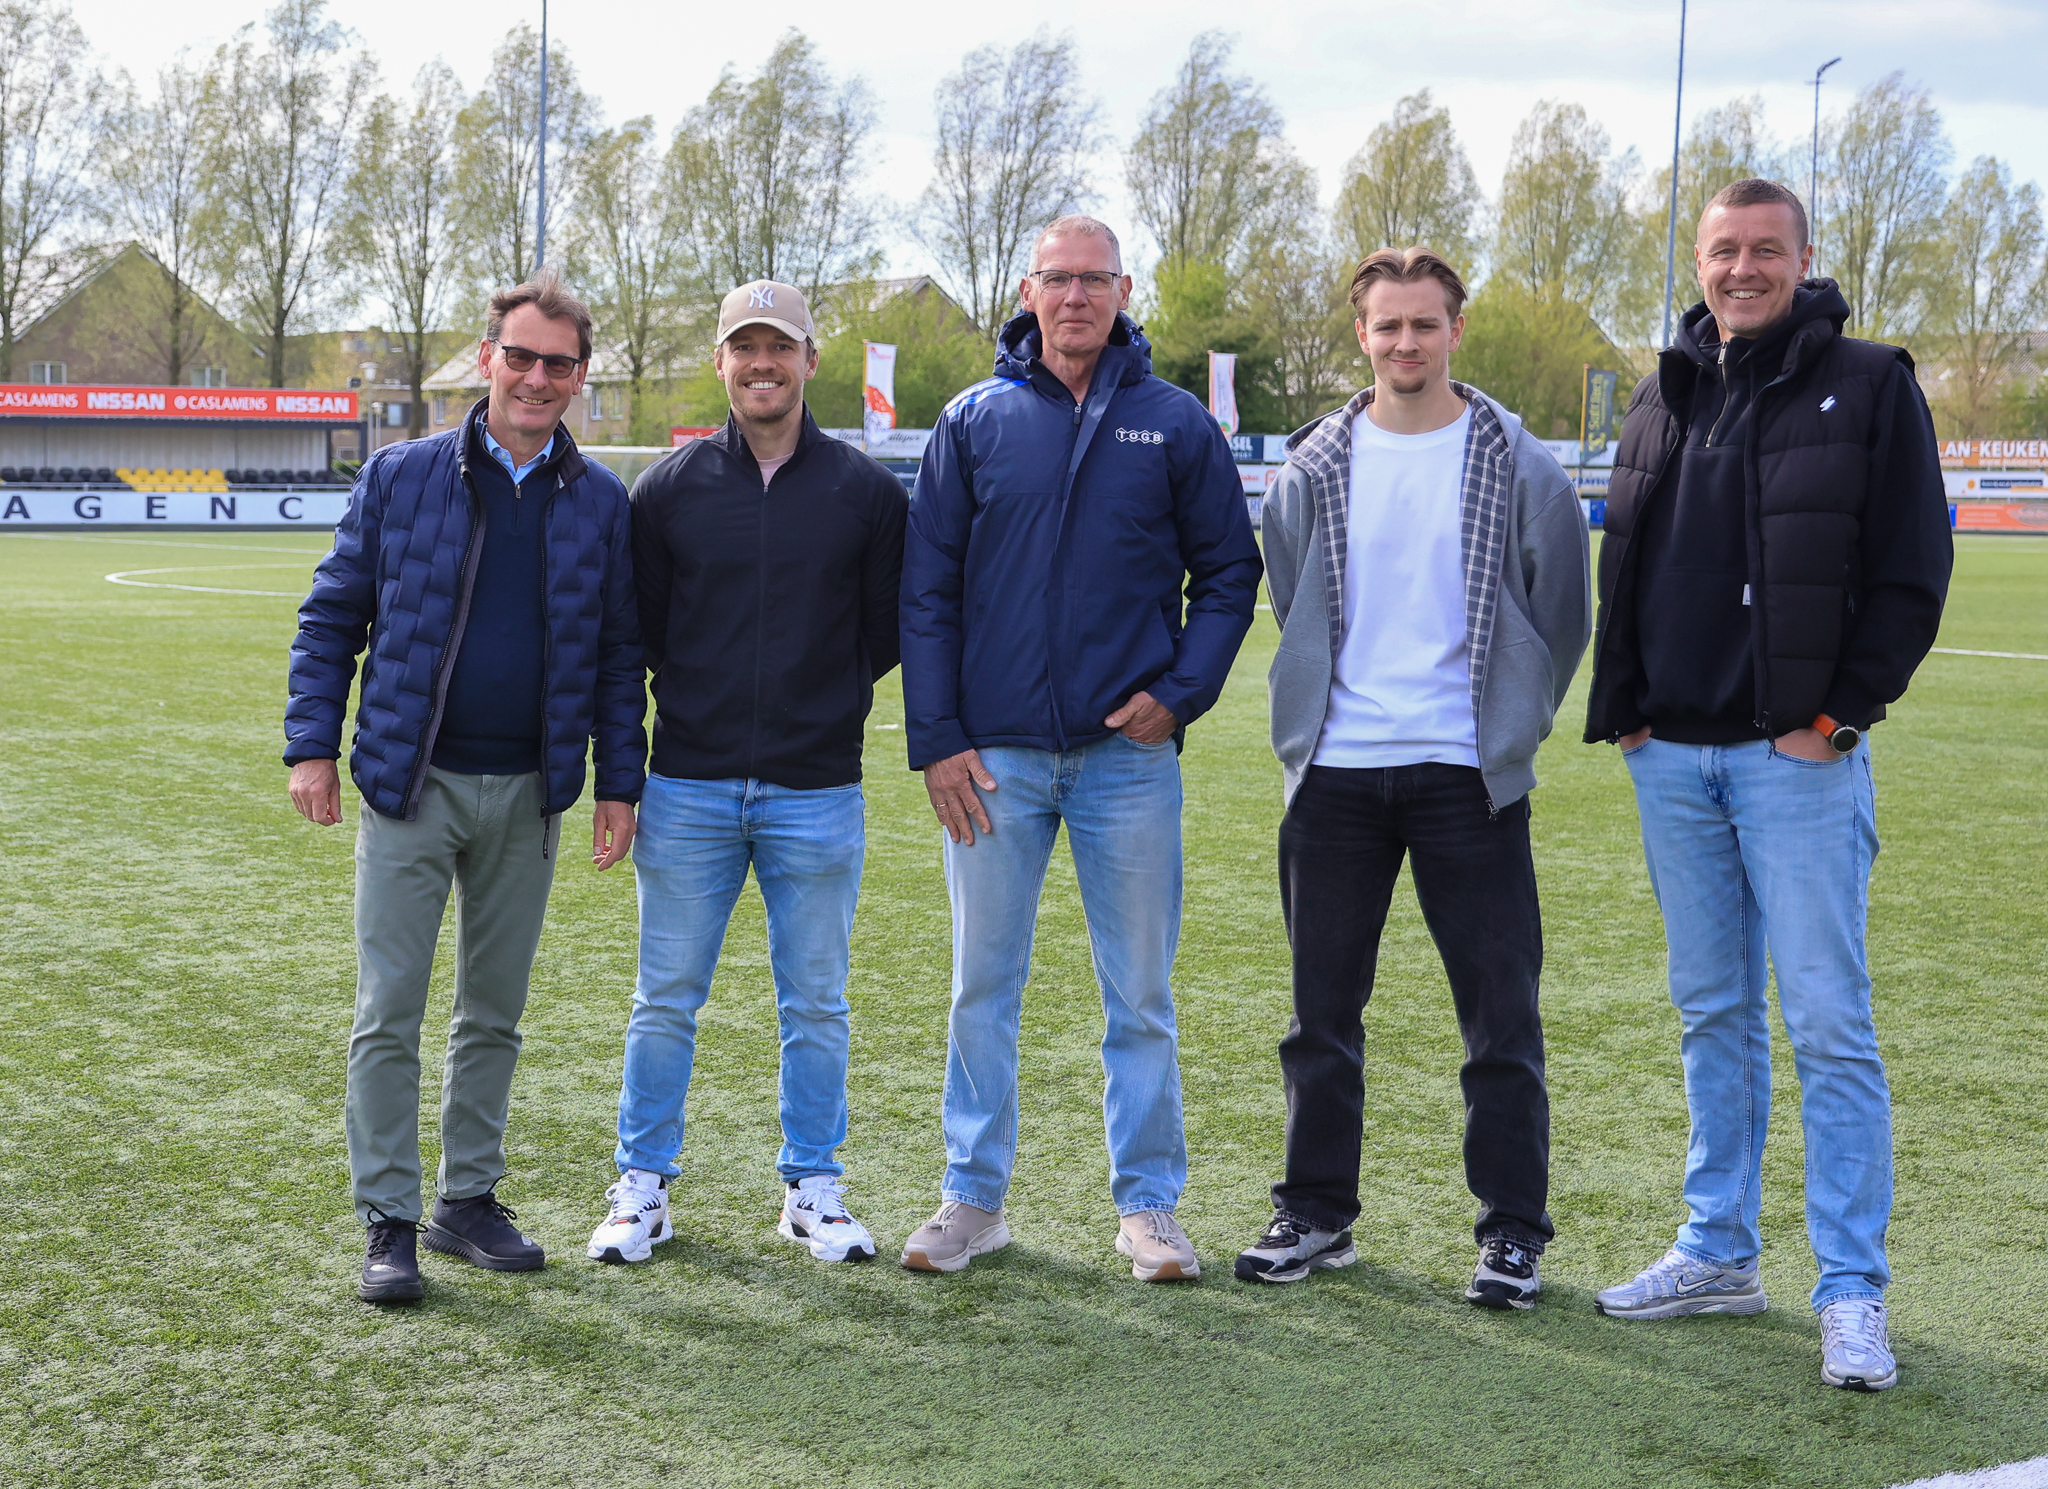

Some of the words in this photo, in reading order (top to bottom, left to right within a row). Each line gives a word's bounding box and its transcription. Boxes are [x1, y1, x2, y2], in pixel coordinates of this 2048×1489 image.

[749, 285, 775, 309] NY
[87, 392, 165, 410] NISSAN
[276, 395, 350, 414] NISSAN
[1117, 429, 1162, 442] TOGB
[3, 496, 351, 520] AGENC
